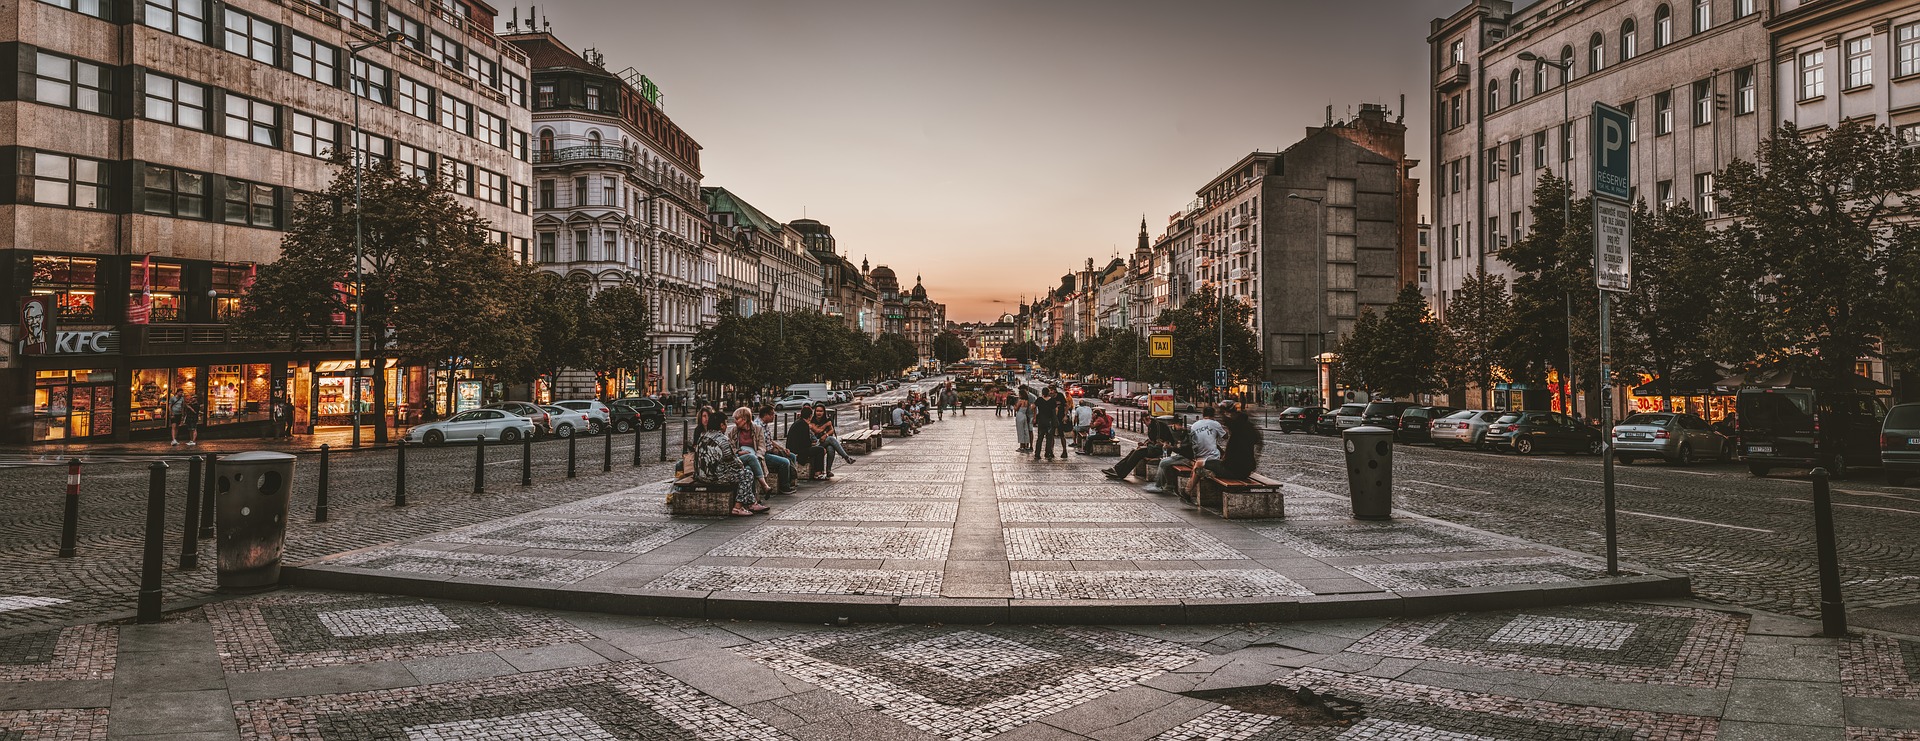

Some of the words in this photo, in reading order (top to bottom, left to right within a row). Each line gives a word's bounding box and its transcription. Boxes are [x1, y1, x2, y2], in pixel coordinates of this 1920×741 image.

[1603, 117, 1622, 167] P
[1598, 171, 1626, 188] RÉSERVÉ
[55, 331, 109, 353] KFC
[1154, 341, 1168, 350] TAXI
